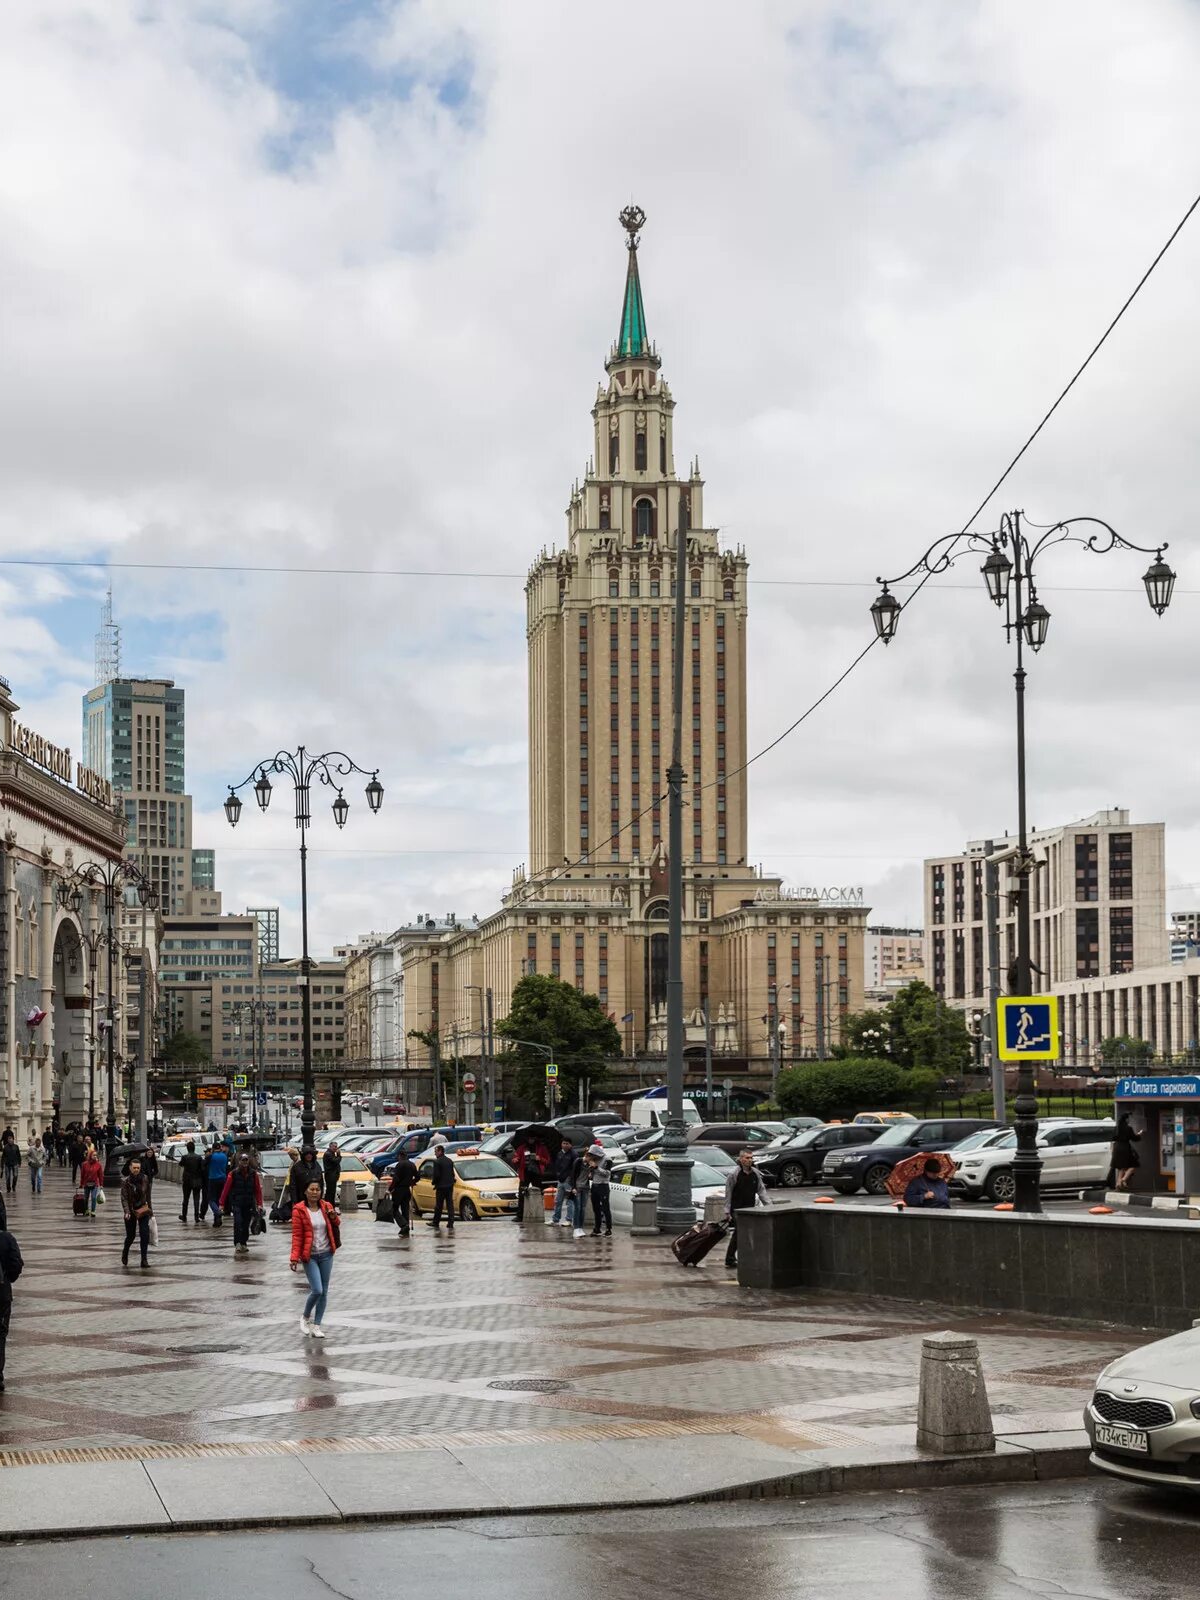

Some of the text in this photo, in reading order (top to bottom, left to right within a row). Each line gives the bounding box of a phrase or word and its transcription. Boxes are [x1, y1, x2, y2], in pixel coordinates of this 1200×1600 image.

[9, 716, 72, 783] КАЗАНСКИЙ
[754, 886, 864, 902] ЛЕНИНГРАДСКАЯ
[1131, 1080, 1158, 1094] Оплата
[1160, 1083, 1197, 1097] парковки
